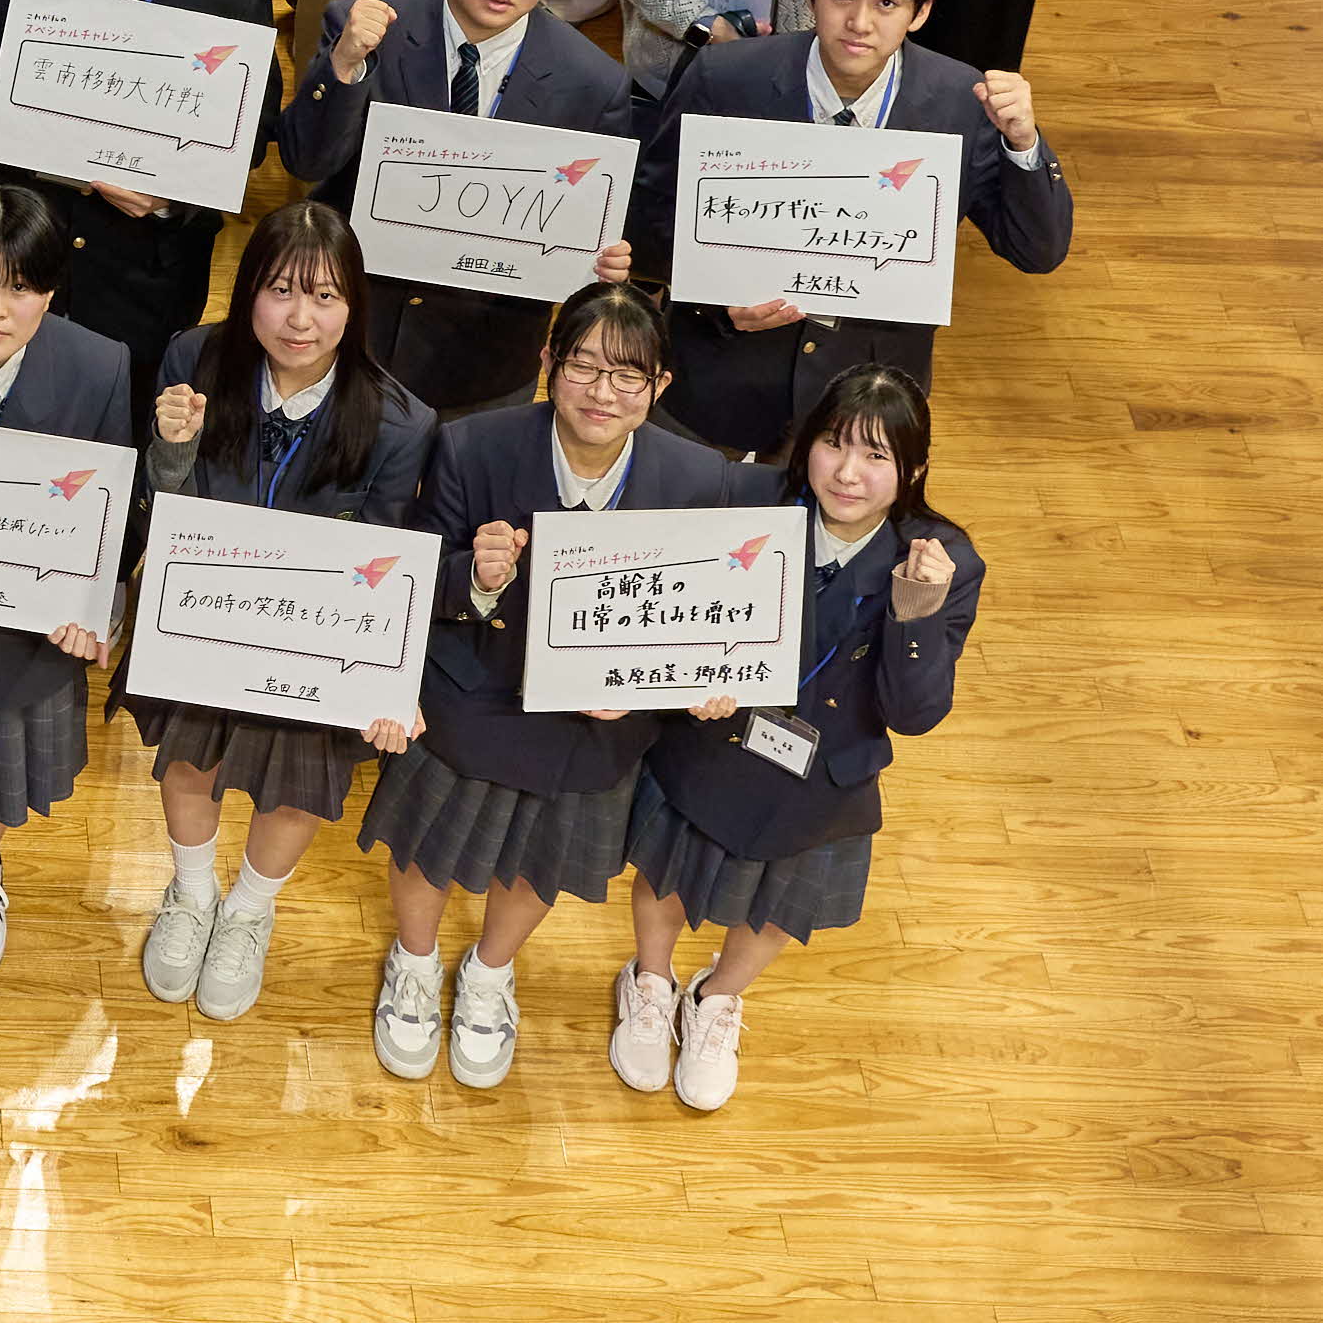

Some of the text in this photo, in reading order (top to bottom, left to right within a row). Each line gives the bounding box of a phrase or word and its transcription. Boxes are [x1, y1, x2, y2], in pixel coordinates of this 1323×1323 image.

[24, 23, 135, 45] スペシャルチャレンジ
[32, 56, 205, 119] 雲南移動大作戦
[382, 145, 494, 162] スペシャルチャレンジ
[699, 159, 814, 172] スペシャルチャレンジ
[417, 173, 565, 234] JOYN
[703, 195, 869, 224] 未来のケアギバーへの
[801, 227, 918, 254] ファーストステップ
[168, 543, 288, 561] スペシャルチャレンジ
[552, 547, 666, 573] スペシャルチャレンジ
[596, 571, 687, 601] 高齢者の
[178, 589, 392, 637] あの時の笑顔をもう一度!
[570, 599, 758, 634] 日常の楽しみを増やす
